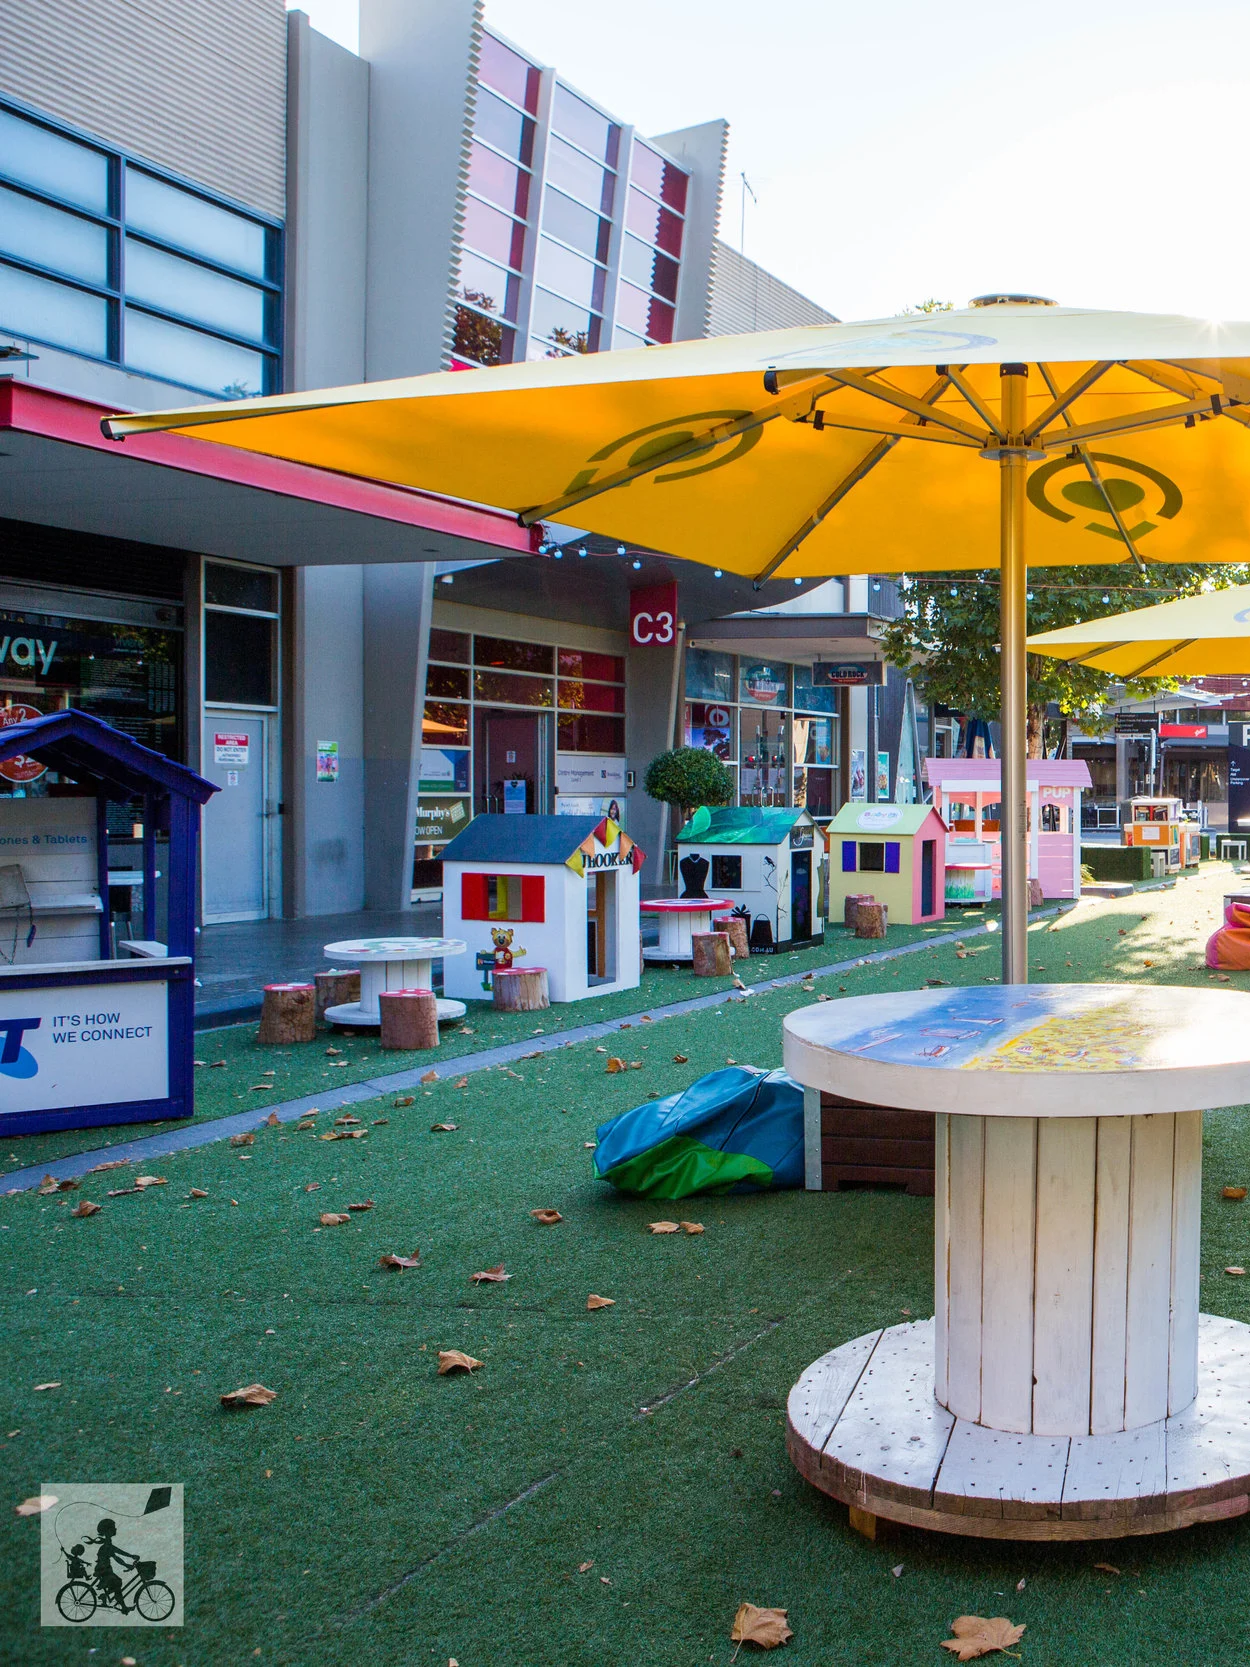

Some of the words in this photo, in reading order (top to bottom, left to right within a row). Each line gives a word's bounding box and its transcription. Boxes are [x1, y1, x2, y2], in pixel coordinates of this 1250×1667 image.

[632, 612, 673, 642] C3
[1043, 787, 1071, 799] PUP
[426, 826, 442, 835] OPEN
[32, 834, 40, 844] &
[43, 834, 87, 845] Tablets
[84, 1013, 121, 1025] HOW
[53, 1031, 78, 1043] WE
[81, 1026, 152, 1041] CONNECT
